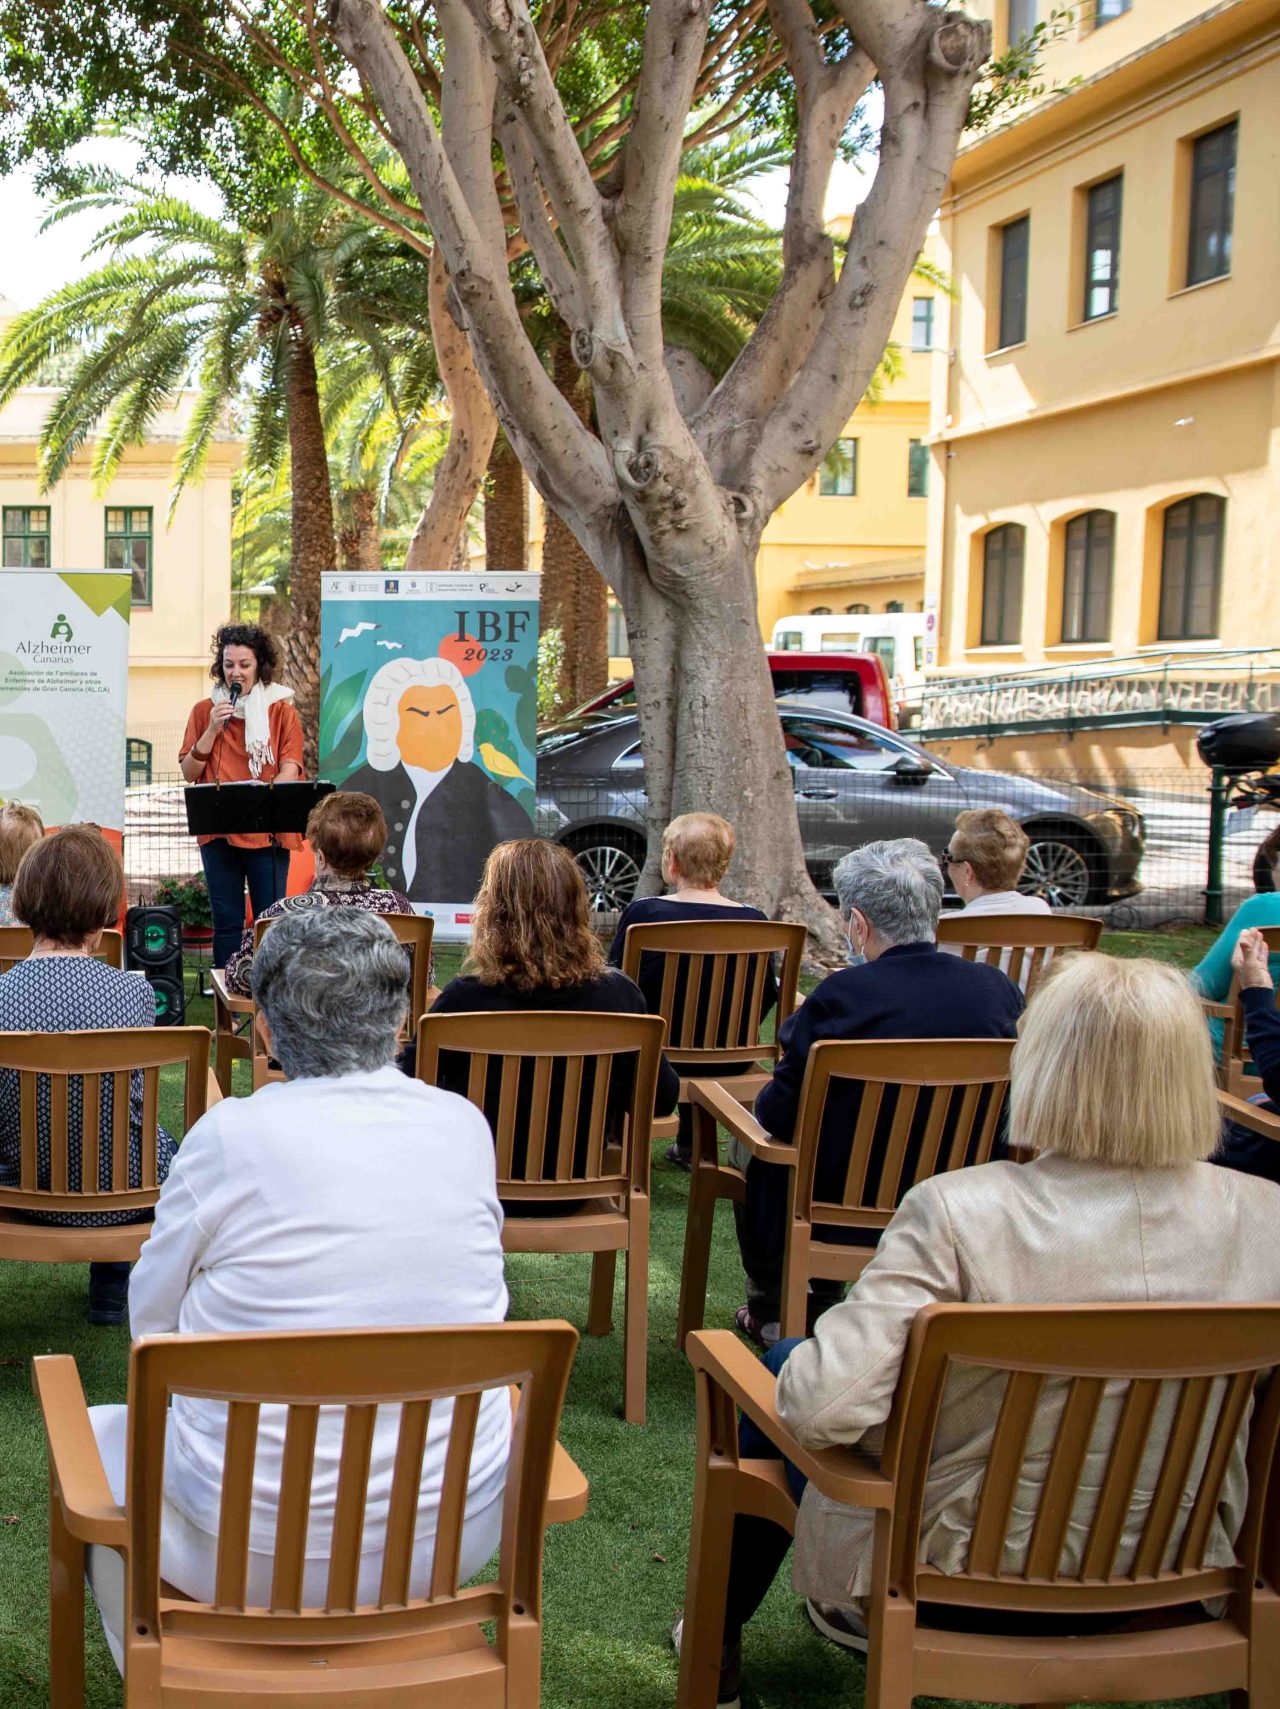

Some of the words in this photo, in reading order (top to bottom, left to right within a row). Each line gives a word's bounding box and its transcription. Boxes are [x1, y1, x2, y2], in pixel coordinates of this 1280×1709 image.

[454, 611, 531, 642] IBF
[16, 640, 92, 655] Alzheimer
[463, 648, 513, 661] 2023
[33, 655, 74, 664] Canarias
